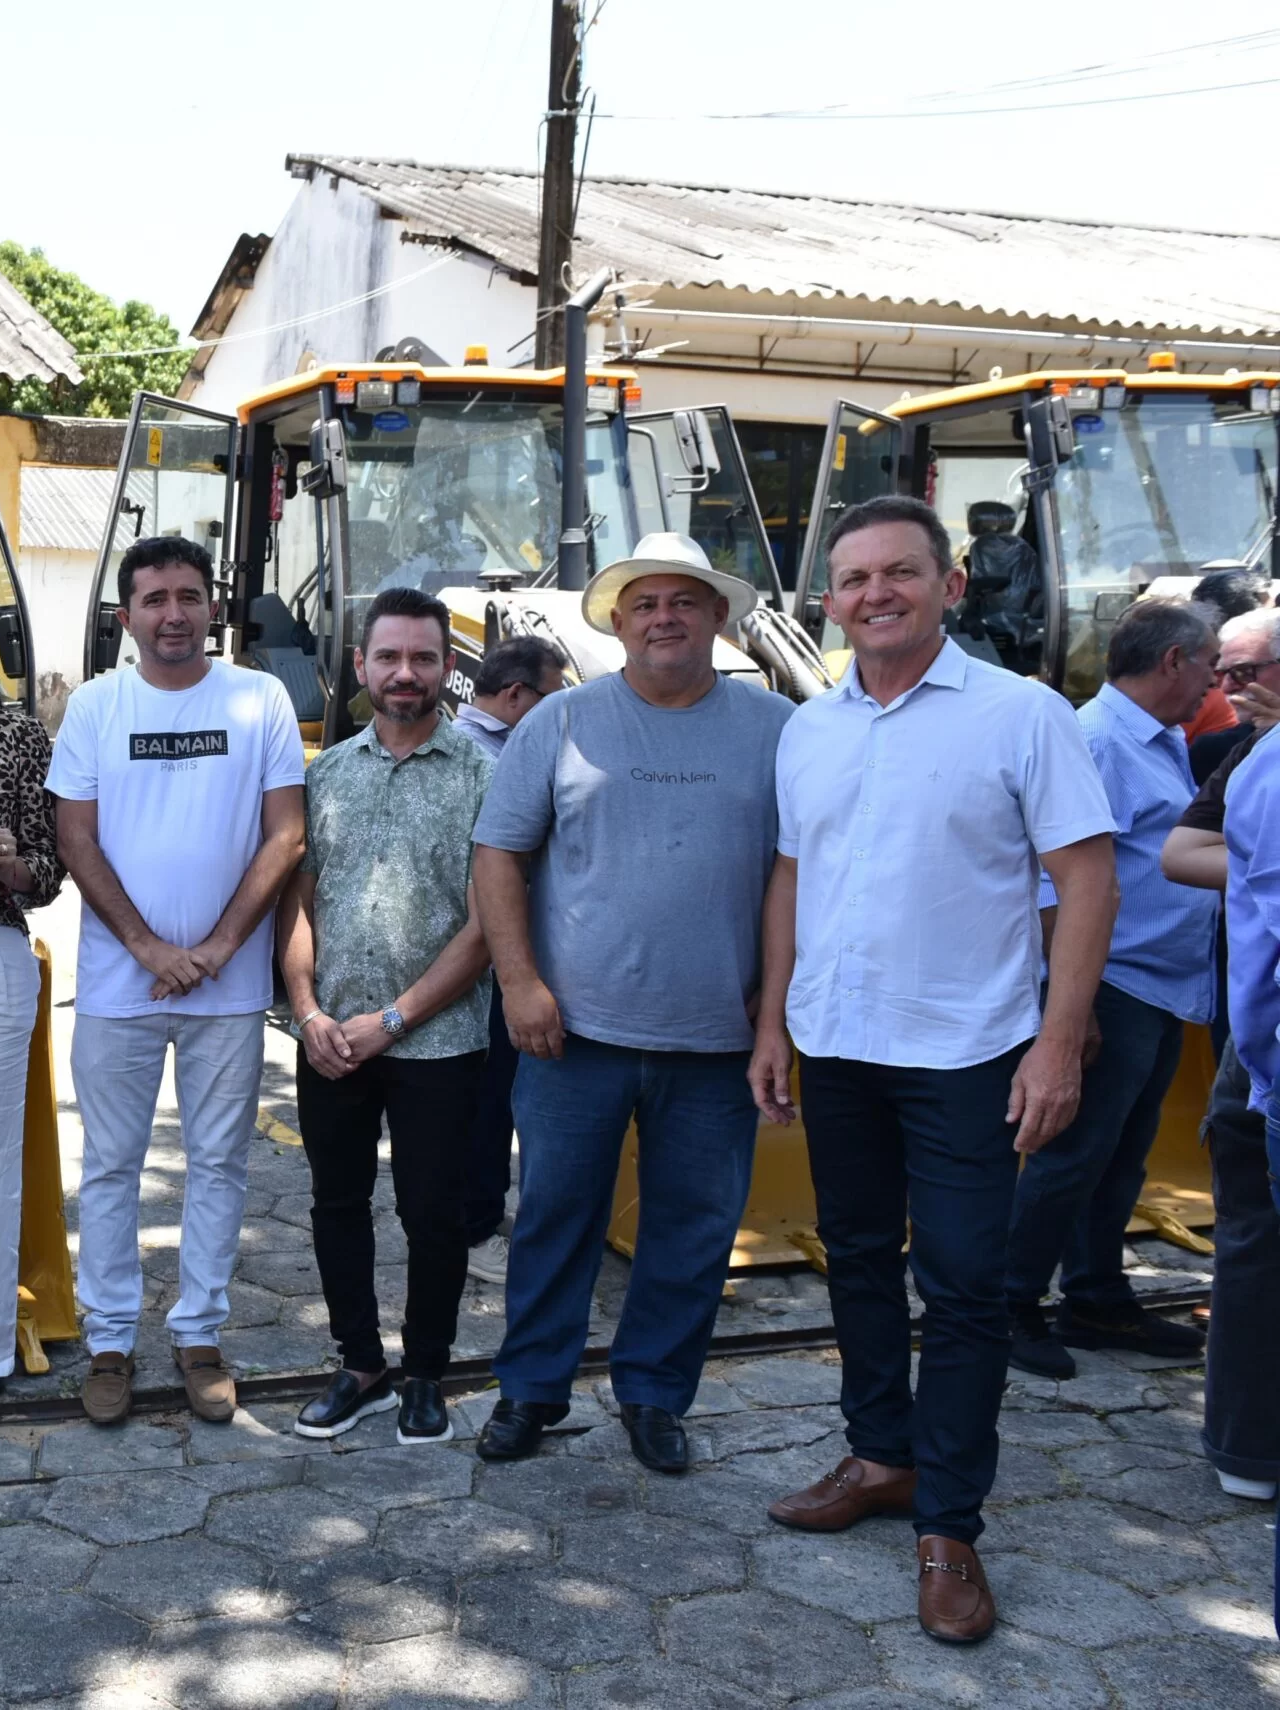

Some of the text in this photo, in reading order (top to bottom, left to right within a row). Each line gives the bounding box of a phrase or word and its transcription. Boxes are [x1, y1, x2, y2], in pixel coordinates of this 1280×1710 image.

[134, 735, 223, 755] BALMAIN
[160, 759, 198, 773] PARIS
[630, 767, 677, 784] Calvin
